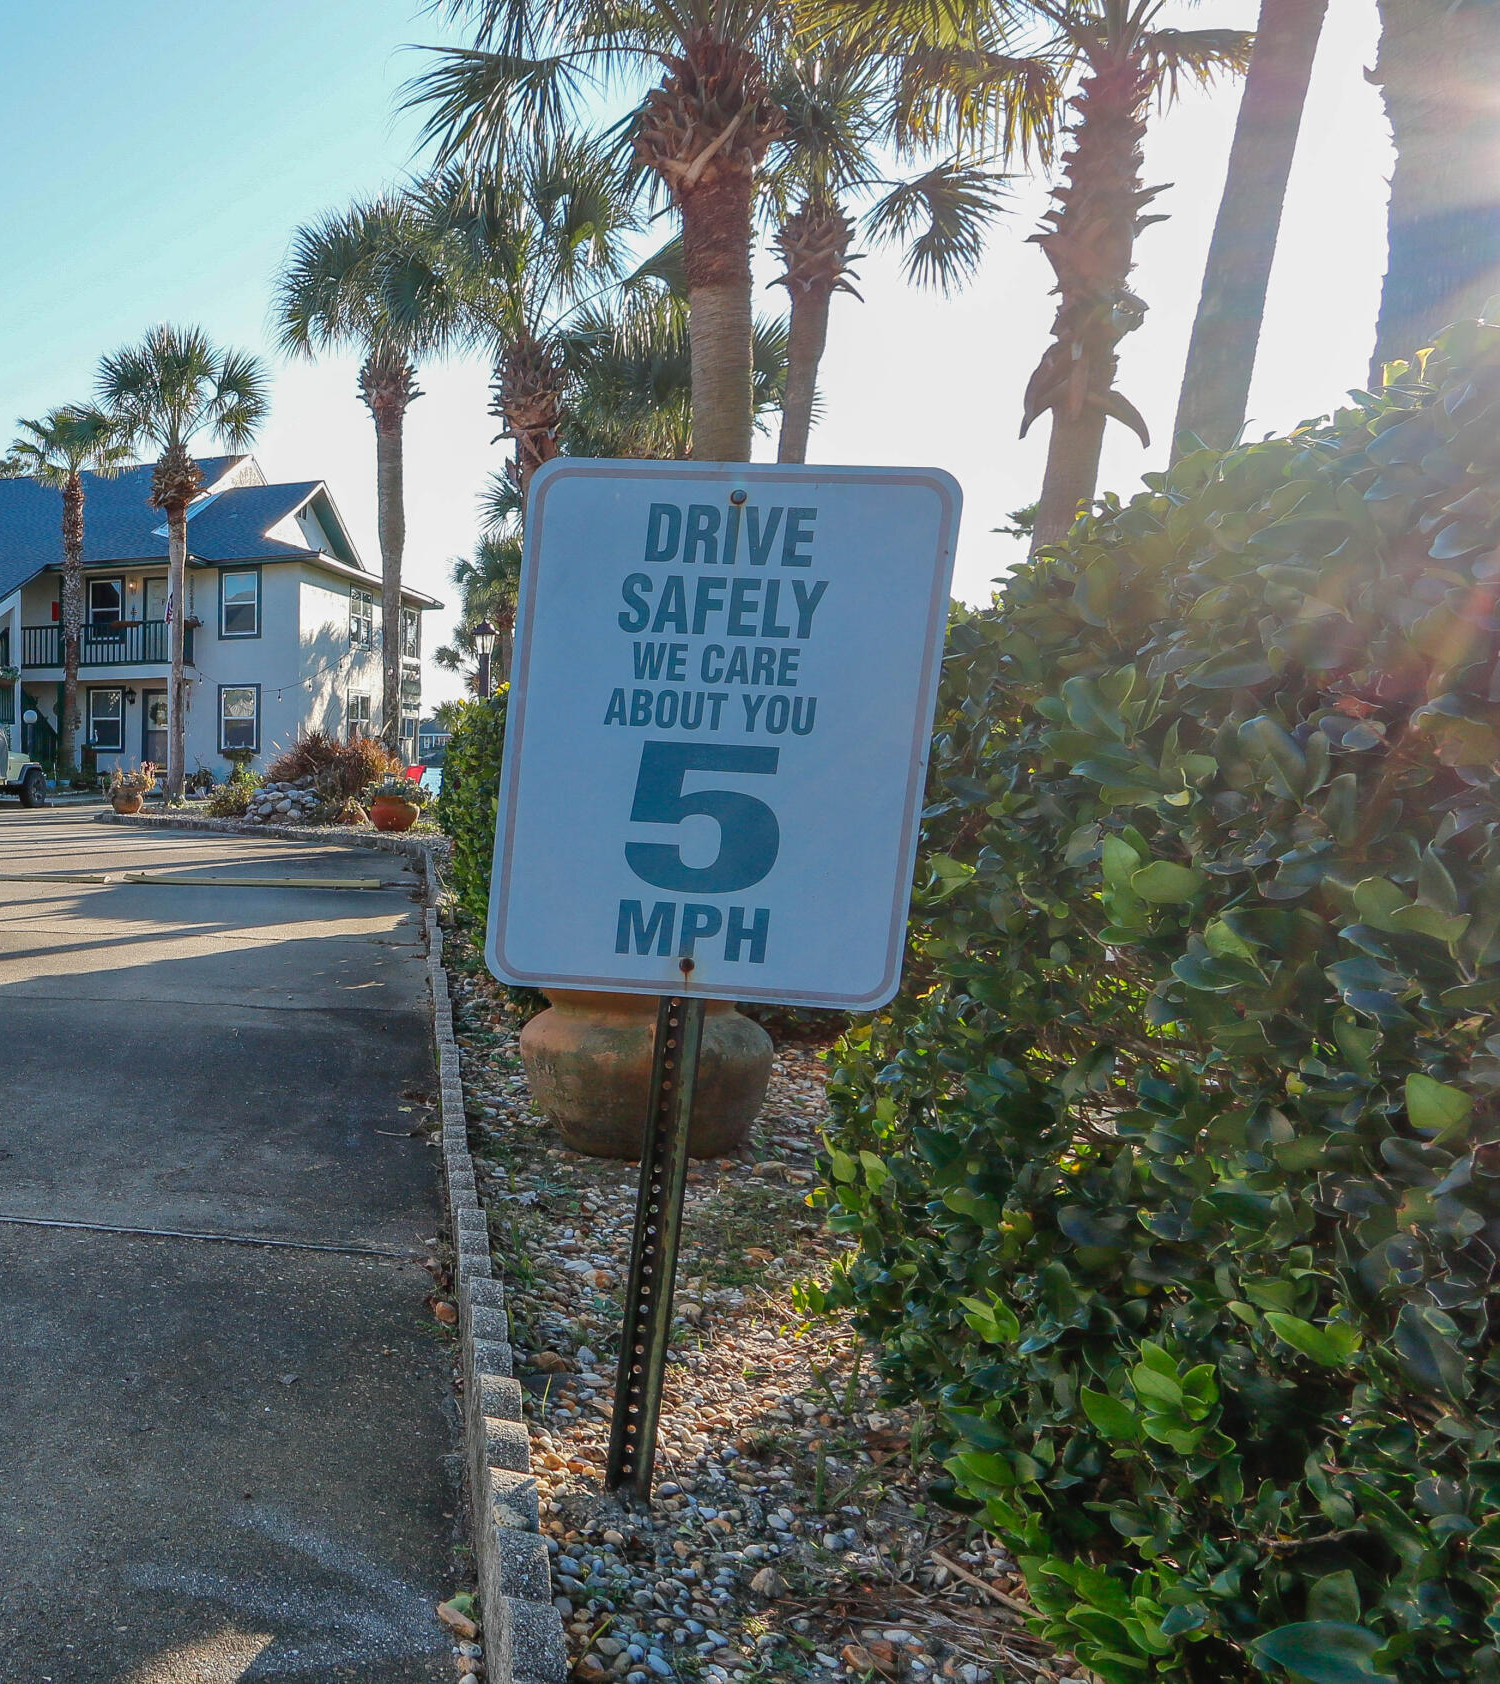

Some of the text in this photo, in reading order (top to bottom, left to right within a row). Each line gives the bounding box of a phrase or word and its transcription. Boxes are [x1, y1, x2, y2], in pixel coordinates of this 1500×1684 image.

[643, 502, 819, 568] DRIVE
[617, 572, 830, 640] SAFELY
[632, 640, 802, 688] WE CARE
[602, 687, 818, 737] ABOUT YOU
[623, 739, 781, 895] 5
[613, 898, 772, 965] MPH
